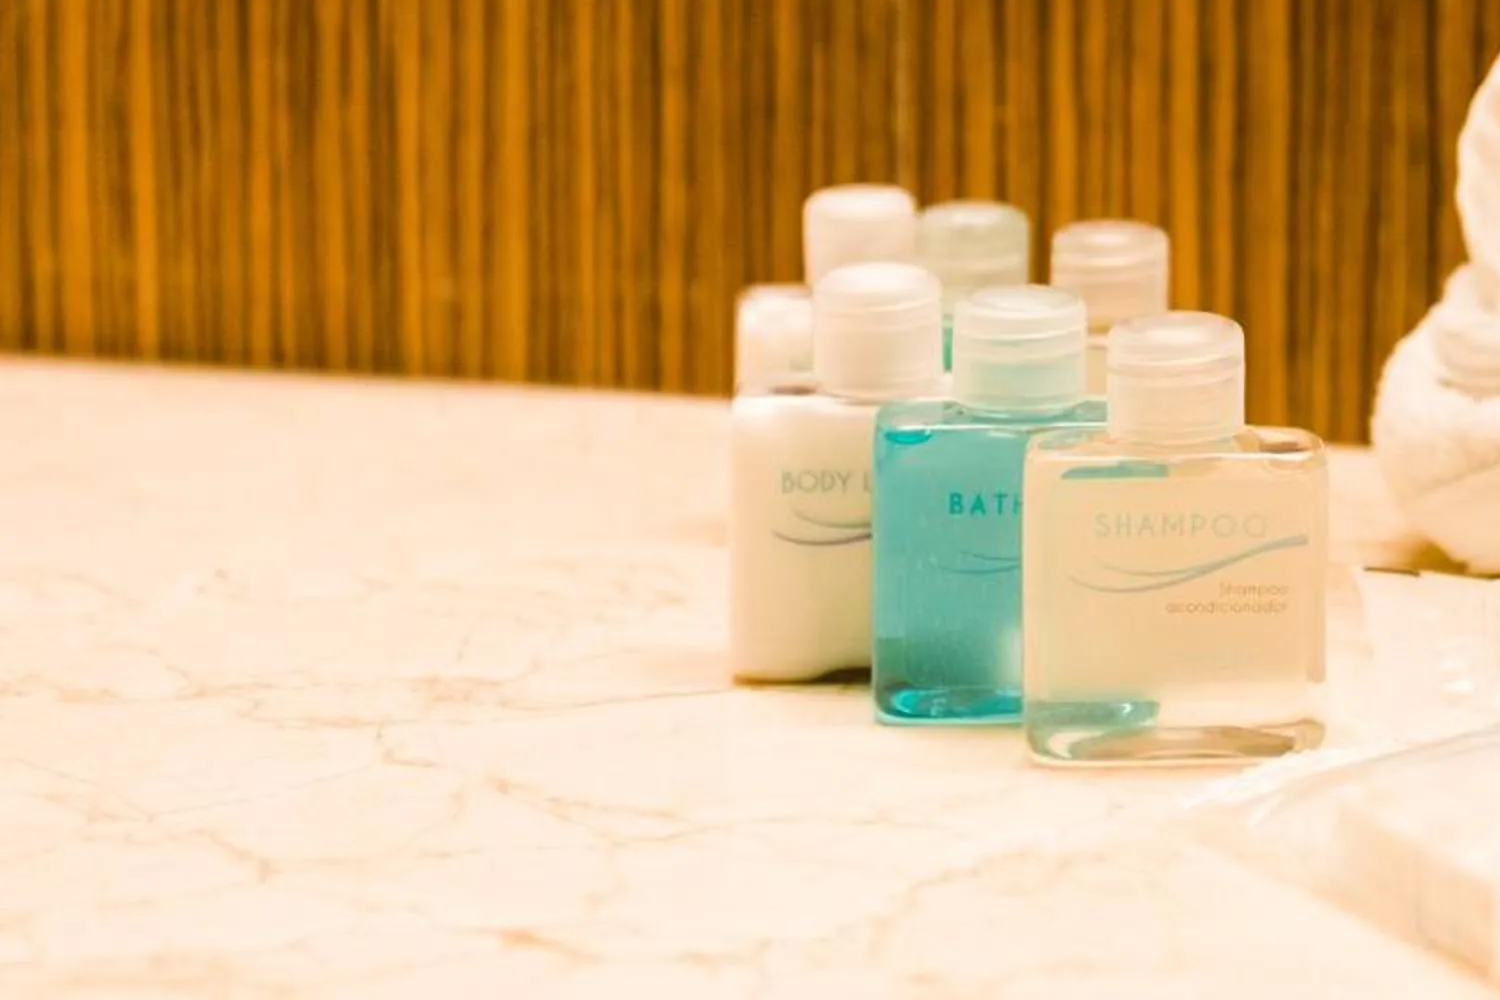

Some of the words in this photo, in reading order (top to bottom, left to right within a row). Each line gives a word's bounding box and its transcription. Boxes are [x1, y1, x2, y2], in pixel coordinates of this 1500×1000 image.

[781, 469, 854, 496] BODY
[1093, 512, 1269, 539] SHAMPOO
[1219, 581, 1290, 600] Shampoo
[1164, 599, 1289, 615] acondicionador
